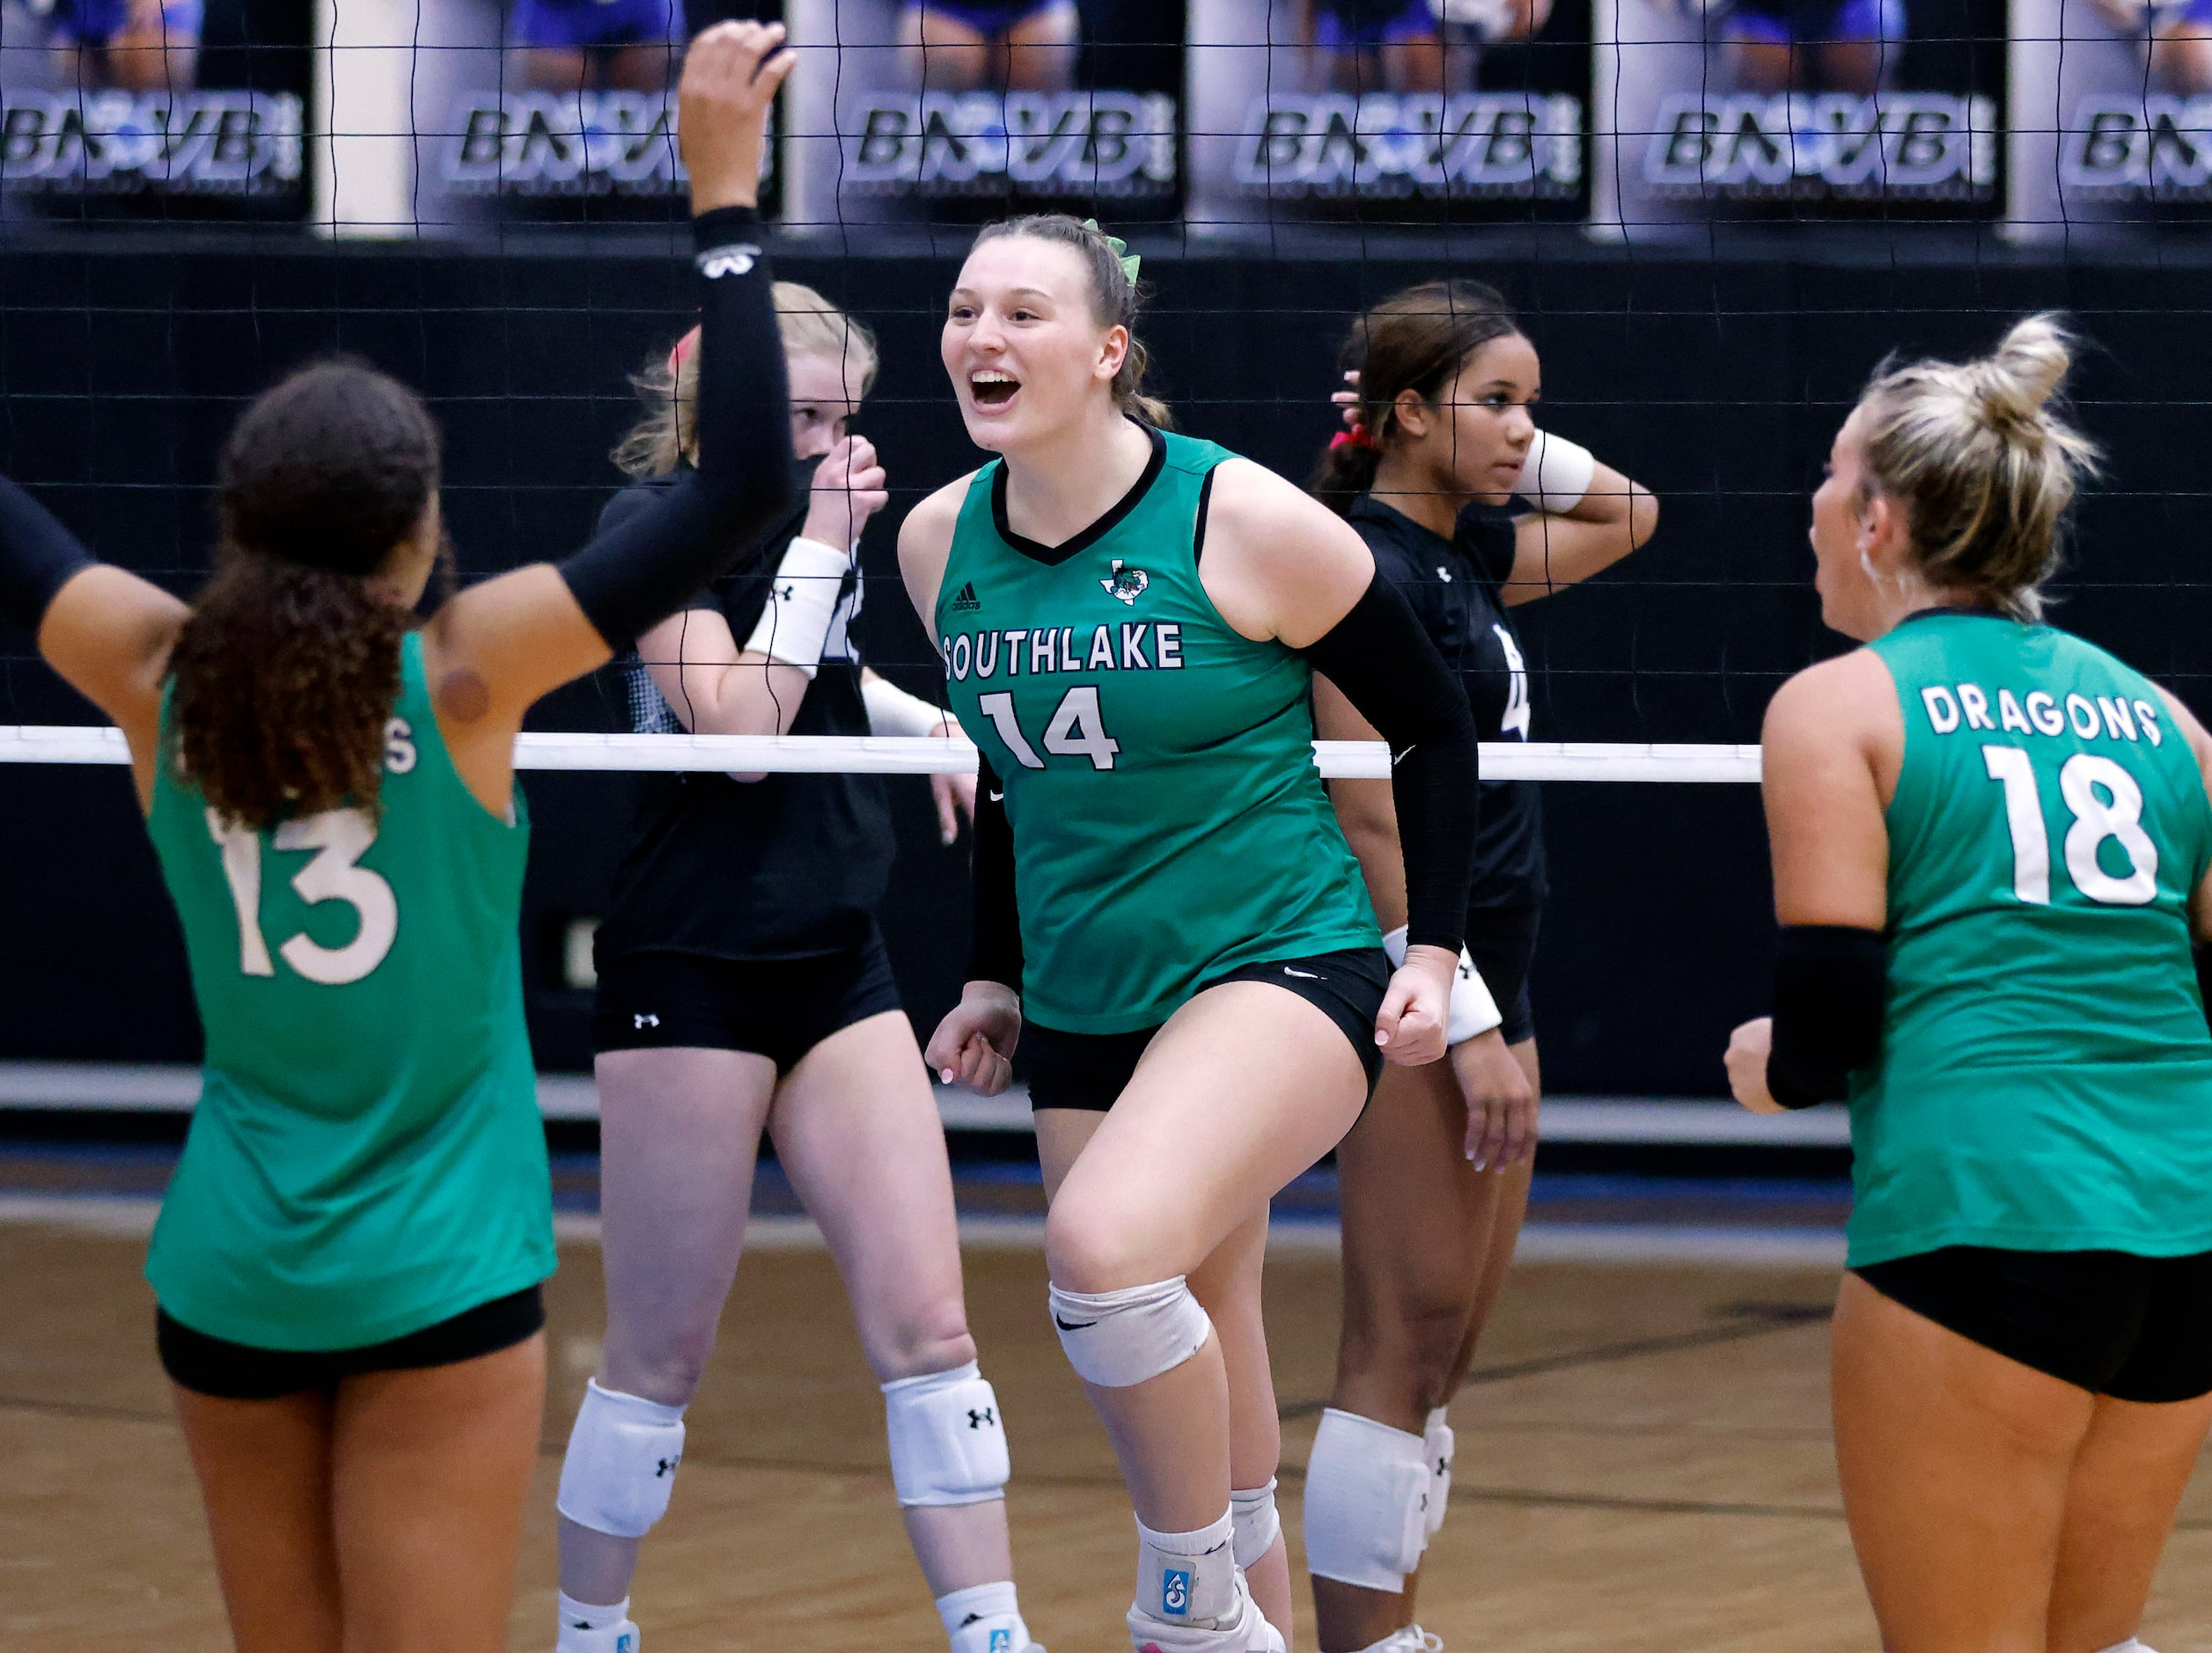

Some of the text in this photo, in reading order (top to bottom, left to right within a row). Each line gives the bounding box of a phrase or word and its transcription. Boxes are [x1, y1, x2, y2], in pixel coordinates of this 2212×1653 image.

[455, 99, 686, 170] BNV
[851, 100, 1139, 173] BNVB
[1247, 100, 1537, 173] BNVB
[1657, 103, 1956, 174] BNVB
[943, 621, 1185, 681] SOUTHLAKE
[977, 684, 1121, 770] 14
[1920, 682, 2162, 746] DRAGONS
[1981, 744, 2159, 905] 18
[204, 804, 398, 985] 13
